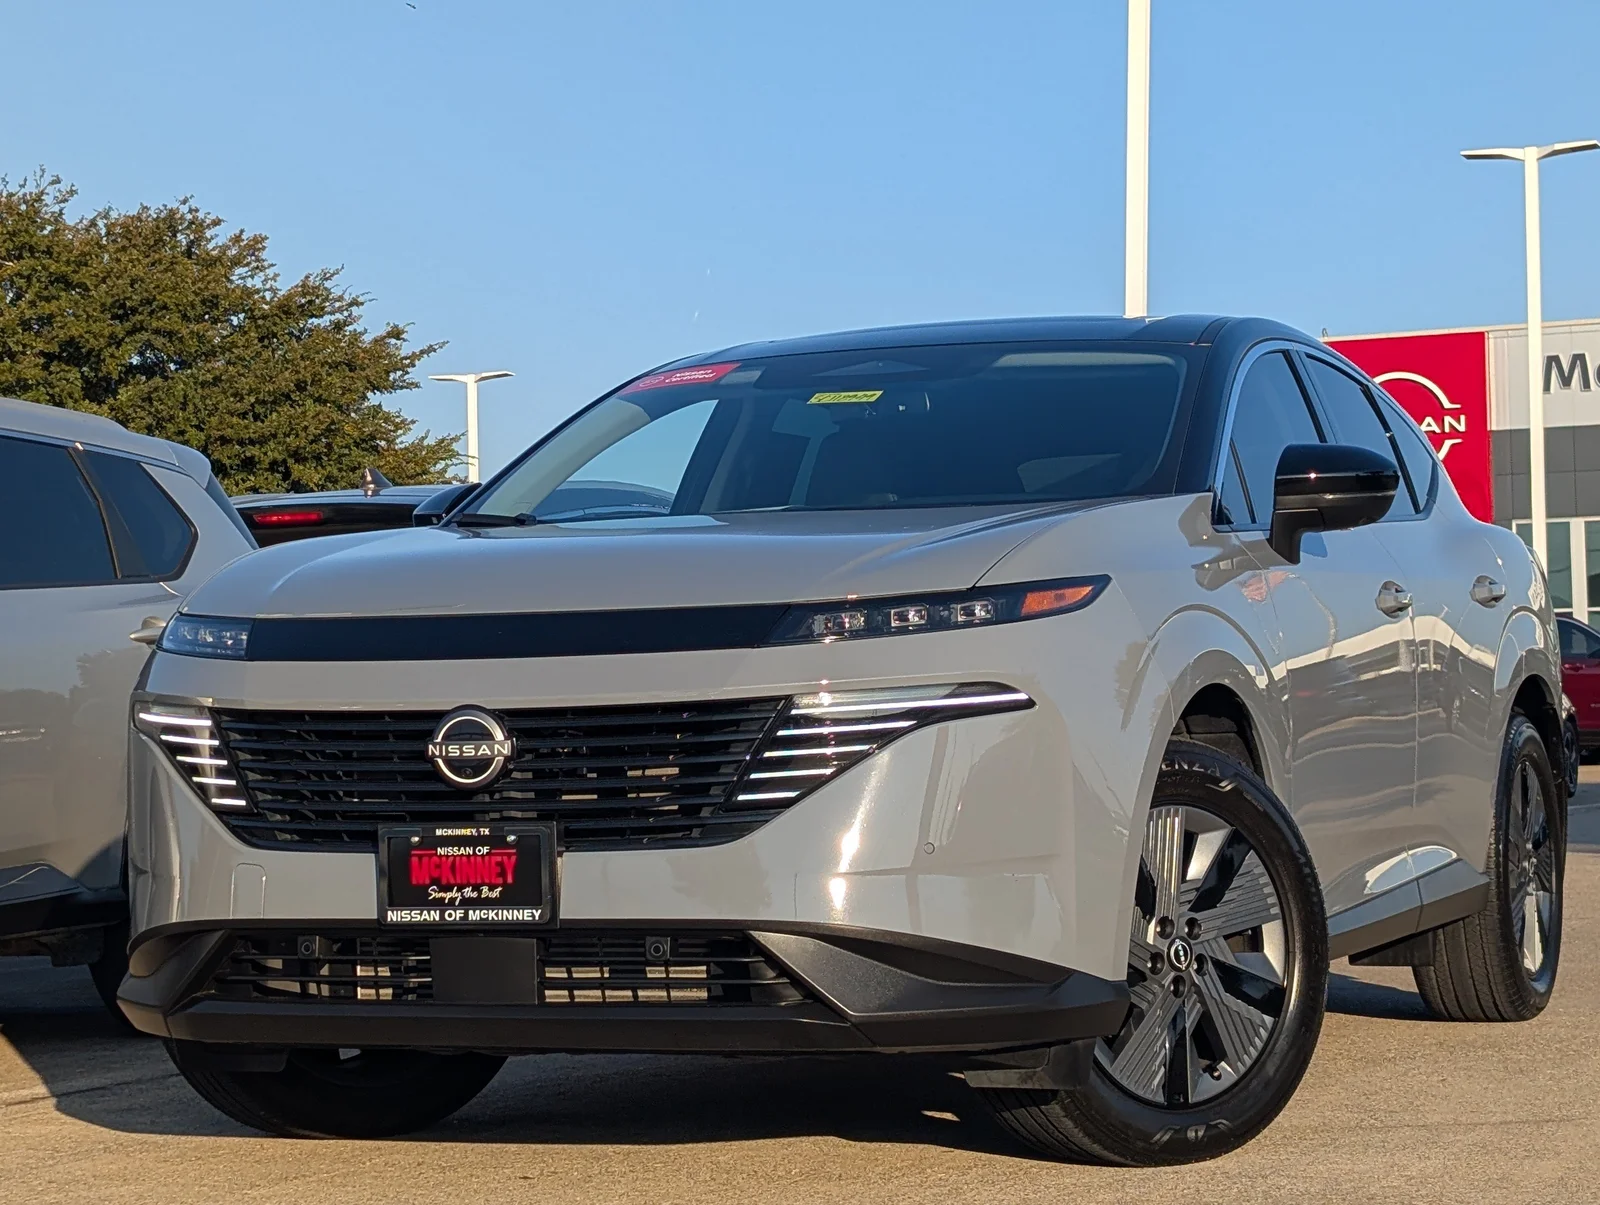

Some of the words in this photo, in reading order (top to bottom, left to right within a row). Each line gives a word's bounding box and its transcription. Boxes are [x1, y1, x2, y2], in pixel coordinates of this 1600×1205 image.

[1542, 352, 1600, 394] M
[428, 744, 508, 756] NISSAN
[437, 846, 473, 856] NISSAN
[475, 846, 491, 855] OF
[428, 885, 463, 906] Simply
[461, 886, 478, 898] the
[480, 886, 503, 898] Best
[387, 910, 440, 922] NISSAN
[444, 909, 465, 921] OF
